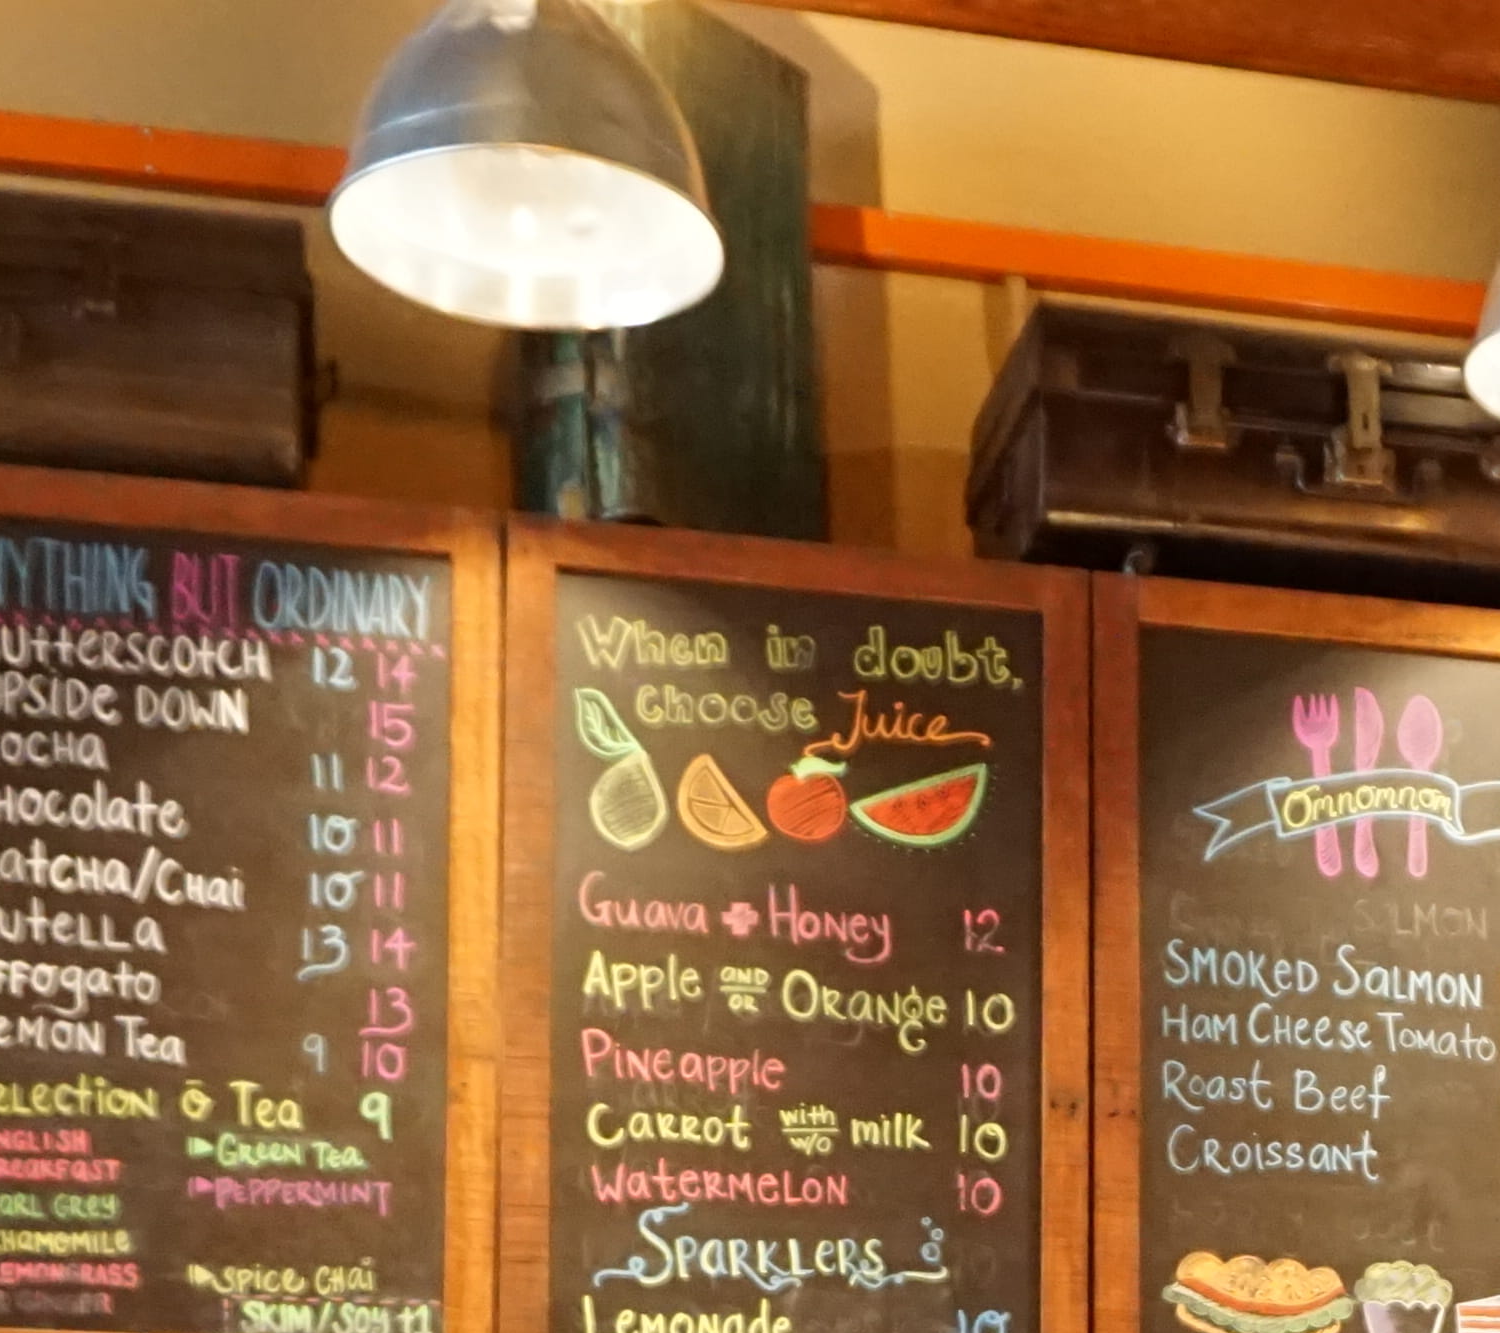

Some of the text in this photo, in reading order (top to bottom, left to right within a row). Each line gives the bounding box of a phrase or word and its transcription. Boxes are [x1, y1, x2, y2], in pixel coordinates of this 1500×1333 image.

[168, 551, 242, 626] BUT
[251, 561, 431, 640] ORDINARY
[310, 646, 418, 692] 12 14
[575, 613, 1024, 690] When in doubt,
[135, 683, 416, 751] DOWN 15
[804, 689, 991, 758] Juice
[310, 753, 344, 792] 11
[365, 755, 412, 796] 12
[309, 813, 359, 854] 10
[371, 818, 403, 856] 11
[309, 869, 404, 910] 10 11
[577, 869, 708, 936] Guava
[962, 908, 1005, 954] 12
[298, 923, 351, 980] 13
[369, 924, 416, 970] 14
[358, 987, 414, 1038] 13
[583, 950, 703, 1012] Apple
[727, 994, 759, 1014] OR
[963, 992, 1016, 1033] 10
[114, 1013, 188, 1066] Tea
[301, 1033, 327, 1074] 9
[361, 1041, 406, 1080] 10
[229, 1079, 392, 1141] Tea 9
[961, 1063, 1003, 1101] 10
[1162, 1059, 1274, 1112] Roast
[1295, 1064, 1391, 1119] Beef
[779, 1102, 839, 1129] with
[851, 1113, 931, 1150] milk
[958, 1117, 1009, 1159] 10
[957, 1172, 1002, 1216] 10
